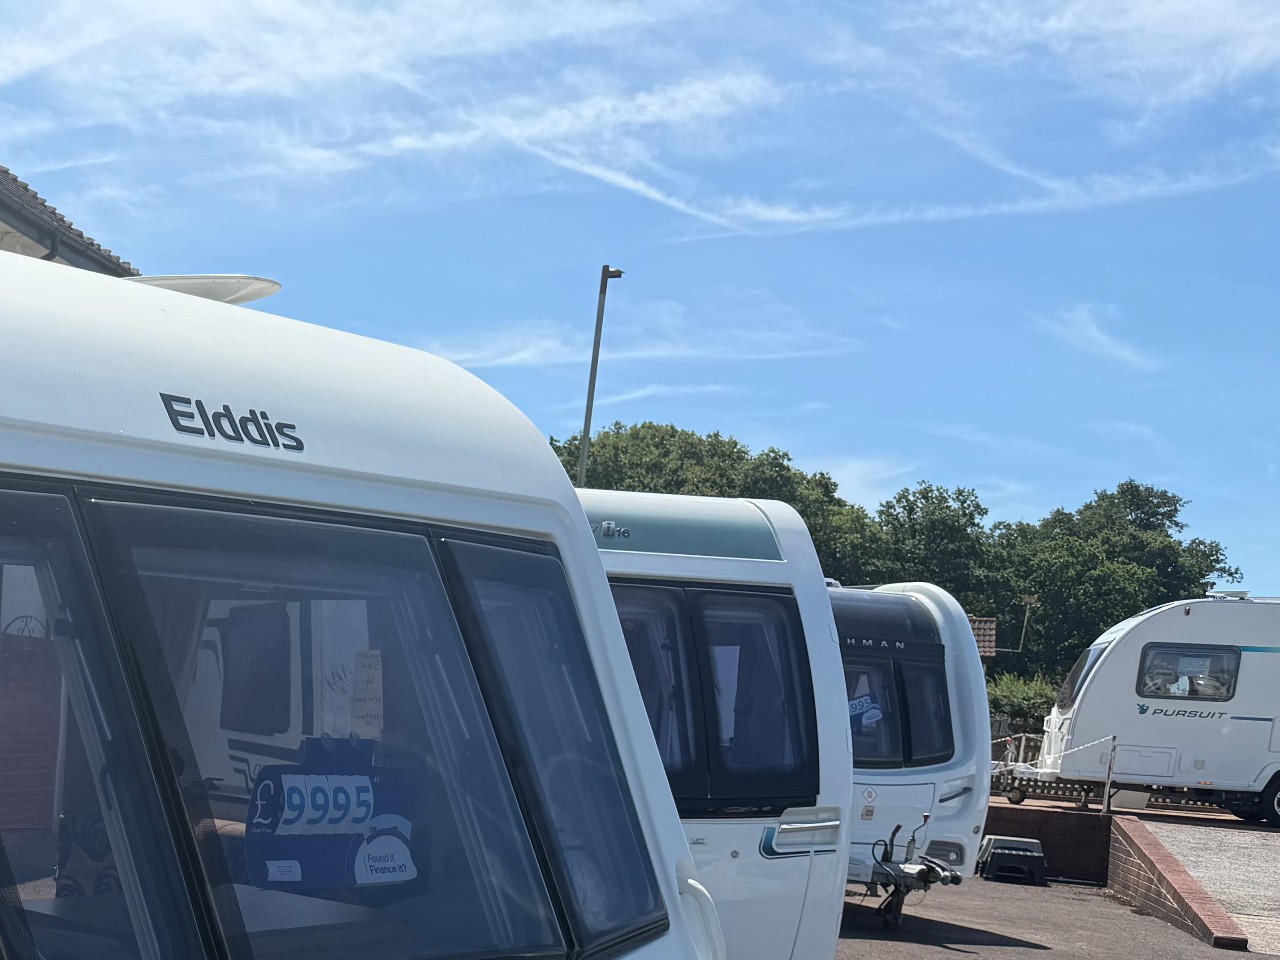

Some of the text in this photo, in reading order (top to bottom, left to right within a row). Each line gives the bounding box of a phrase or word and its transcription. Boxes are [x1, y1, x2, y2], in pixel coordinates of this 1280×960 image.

[158, 392, 305, 453] Elddis
[846, 638, 905, 649] HMAN
[850, 697, 872, 713] 995
[1151, 708, 1227, 719] PURSUIT
[367, 853, 389, 863] Found
[369, 863, 407, 875] Finance it?
